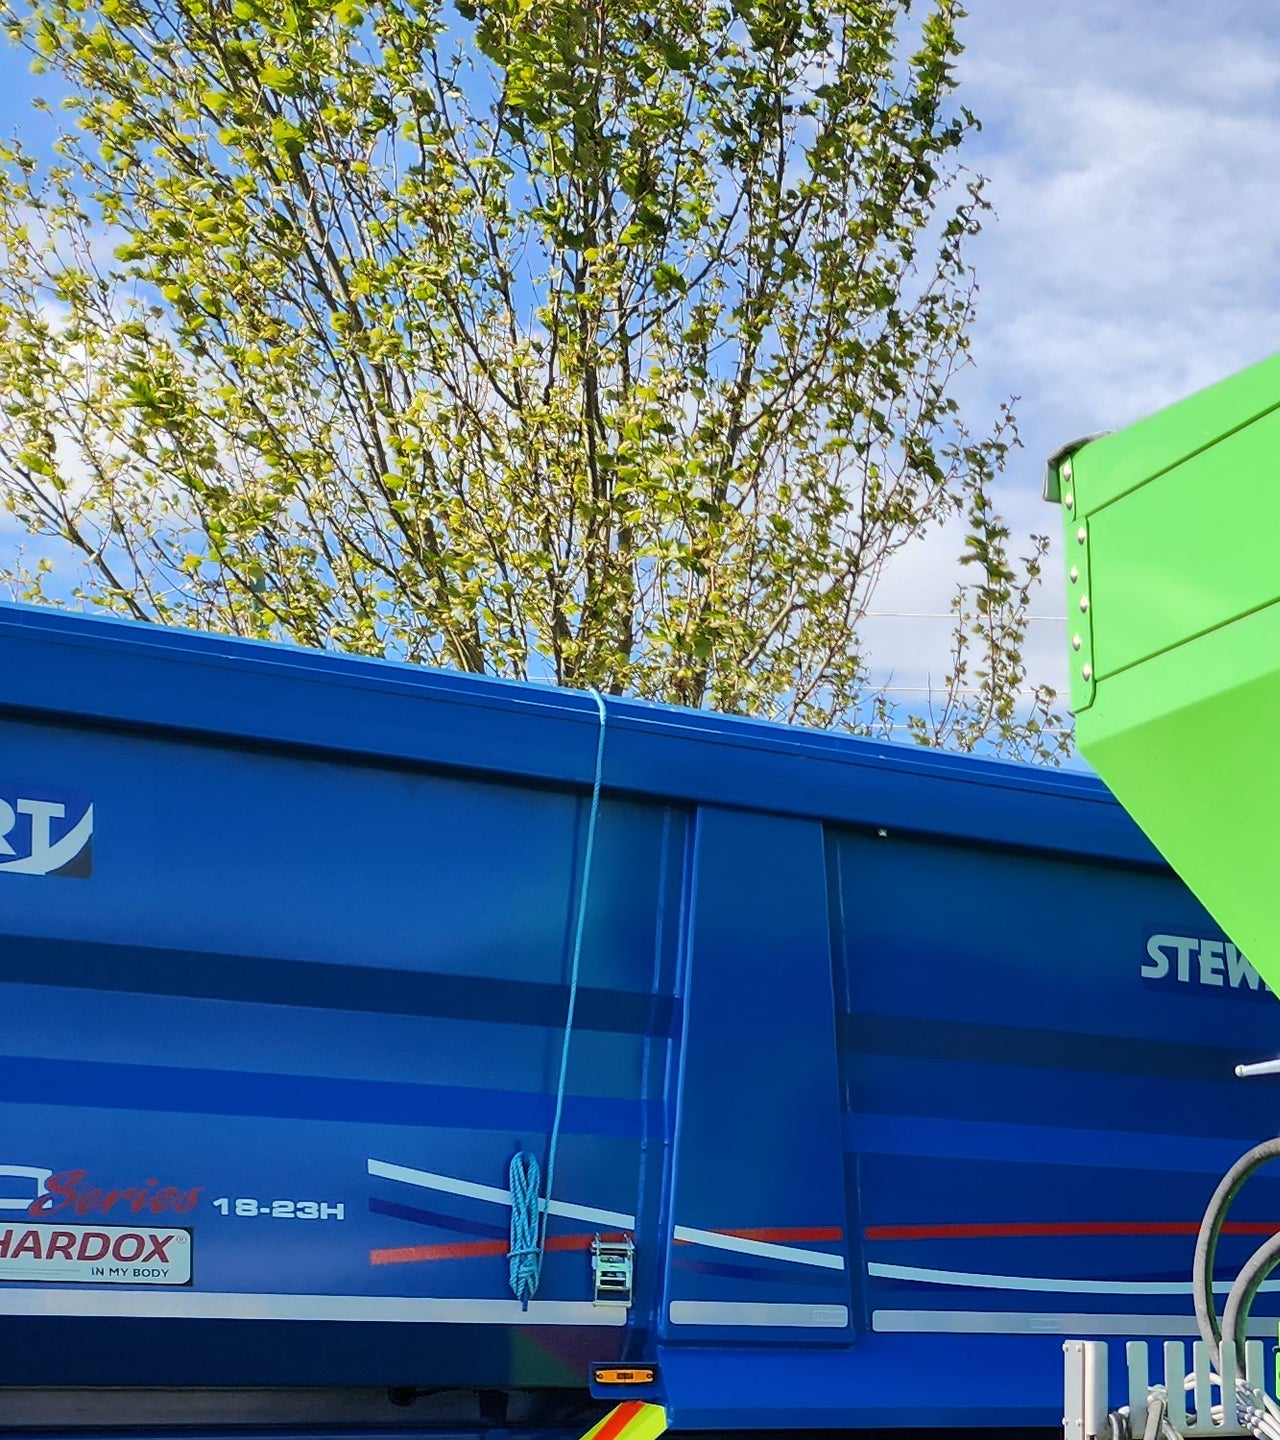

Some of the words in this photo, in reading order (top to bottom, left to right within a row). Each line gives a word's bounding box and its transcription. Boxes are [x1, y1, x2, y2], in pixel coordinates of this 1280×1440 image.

[1141, 934, 1273, 992] STEW
[29, 1169, 206, 1218] Series
[211, 1197, 345, 1221] 18-23H
[90, 1266, 105, 1277] IN
[109, 1267, 129, 1277] MY
[133, 1268, 169, 1278] BODY
